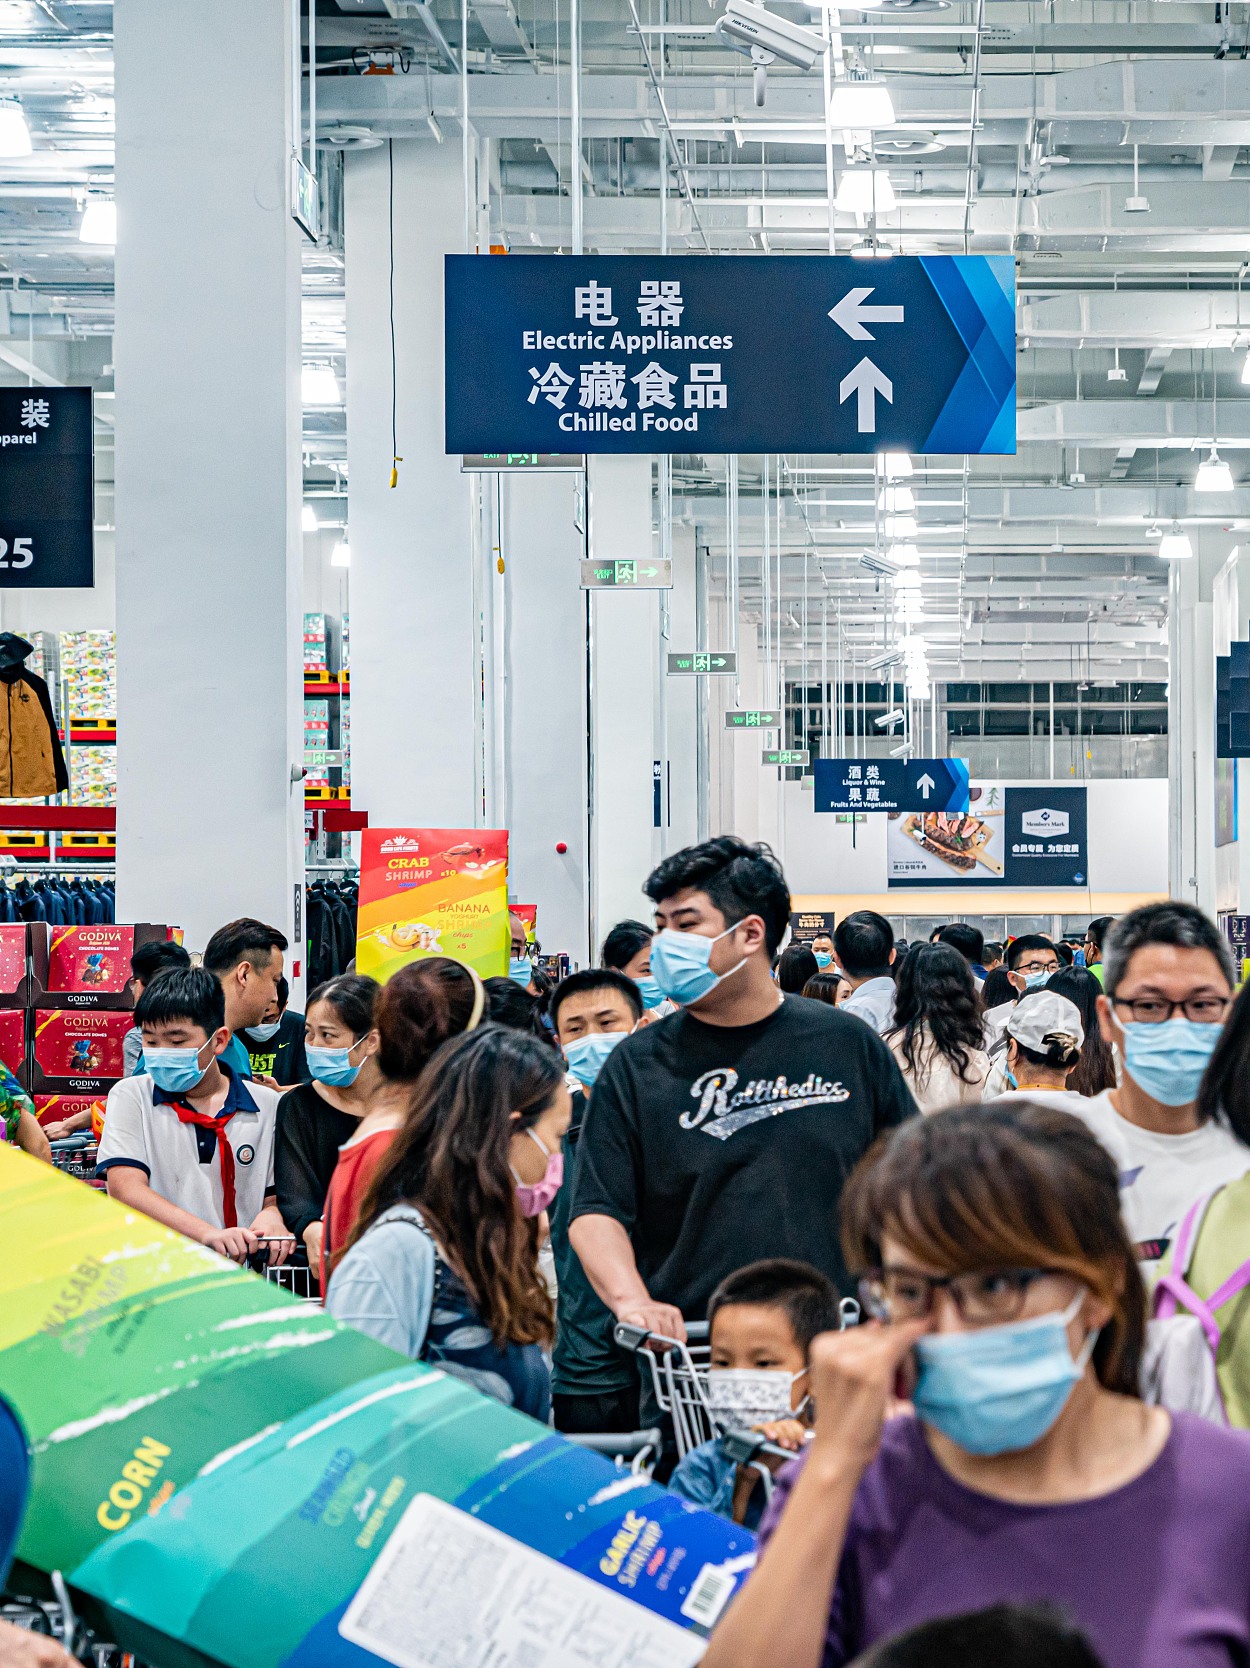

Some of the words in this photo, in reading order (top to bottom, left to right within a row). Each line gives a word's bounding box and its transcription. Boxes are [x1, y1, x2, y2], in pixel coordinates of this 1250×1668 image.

[522, 330, 605, 350] Electric
[610, 330, 734, 355] Appliances
[527, 361, 728, 410] 冷藏食品
[20, 398, 51, 429] 装
[558, 412, 636, 432] Chilled
[642, 412, 698, 432] Food
[0, 432, 37, 447] parel
[848, 765, 880, 779] 酒类
[848, 788, 880, 801] 果蔬
[863, 801, 898, 809] Vegetables
[388, 857, 430, 869] CRAB
[385, 869, 433, 882] SHRIMP
[438, 903, 491, 914] BANANA
[78, 932, 122, 941] GODIVA
[67, 995, 99, 1003] GODIVA
[63, 1017, 109, 1027] GODIVA
[69, 1079, 100, 1087] GODIVA
[96, 1435, 172, 1531] CORN
[599, 1509, 648, 1577] GARLIC
